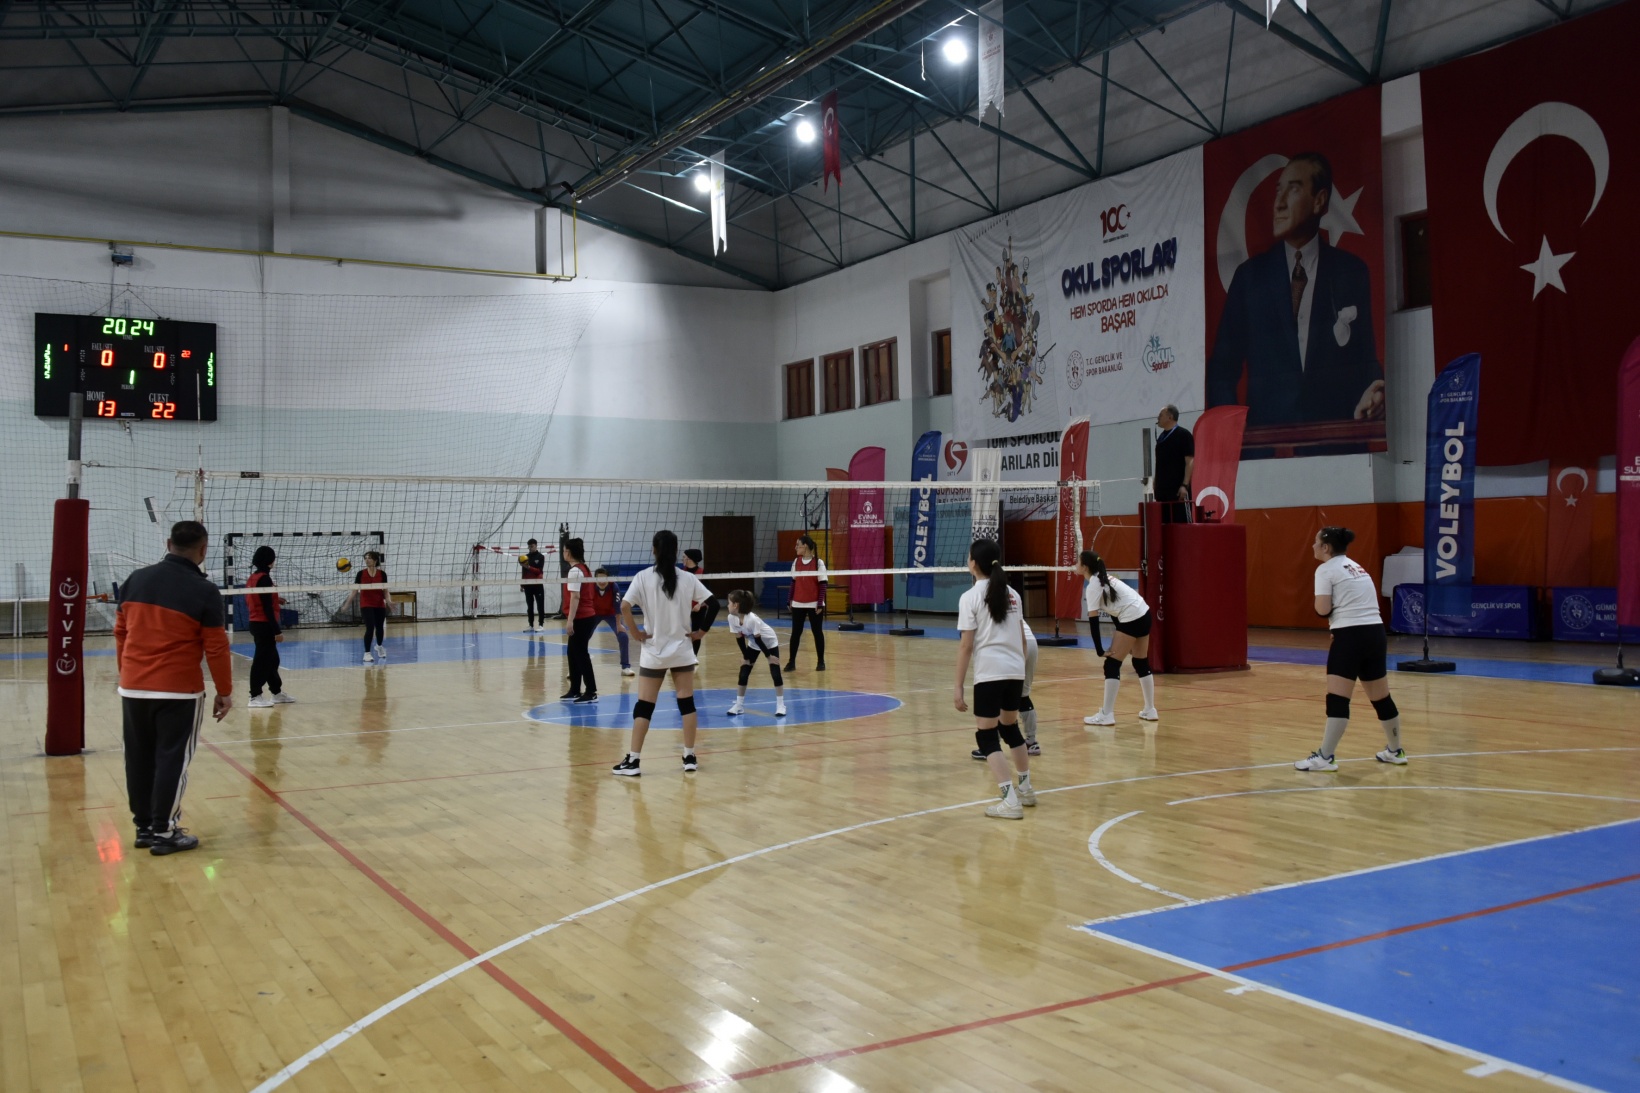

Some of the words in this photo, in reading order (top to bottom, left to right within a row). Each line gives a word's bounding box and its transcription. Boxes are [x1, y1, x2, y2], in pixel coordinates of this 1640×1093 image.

[1061, 262, 1101, 298] OKUL
[1101, 236, 1177, 287] SPORLARI
[1070, 305, 1086, 320] HEM
[1087, 297, 1117, 316] SPORDA
[1119, 292, 1135, 309] HEM
[1136, 284, 1169, 304] OKULDA
[1101, 309, 1136, 333] BAŞARI
[100, 350, 113, 366] 0
[153, 352, 165, 368] 0
[1116, 352, 1123, 360] VE
[1086, 367, 1098, 377] SPOR
[1098, 362, 1123, 375] BAKANLIĞI
[86, 391, 106, 401] HOME
[148, 393, 169, 403] GUEST
[98, 400, 116, 417] 13
[152, 402, 176, 418] 22
[1436, 422, 1464, 579] VOLEYBOL
[1471, 602, 1495, 610] GENÇLİK
